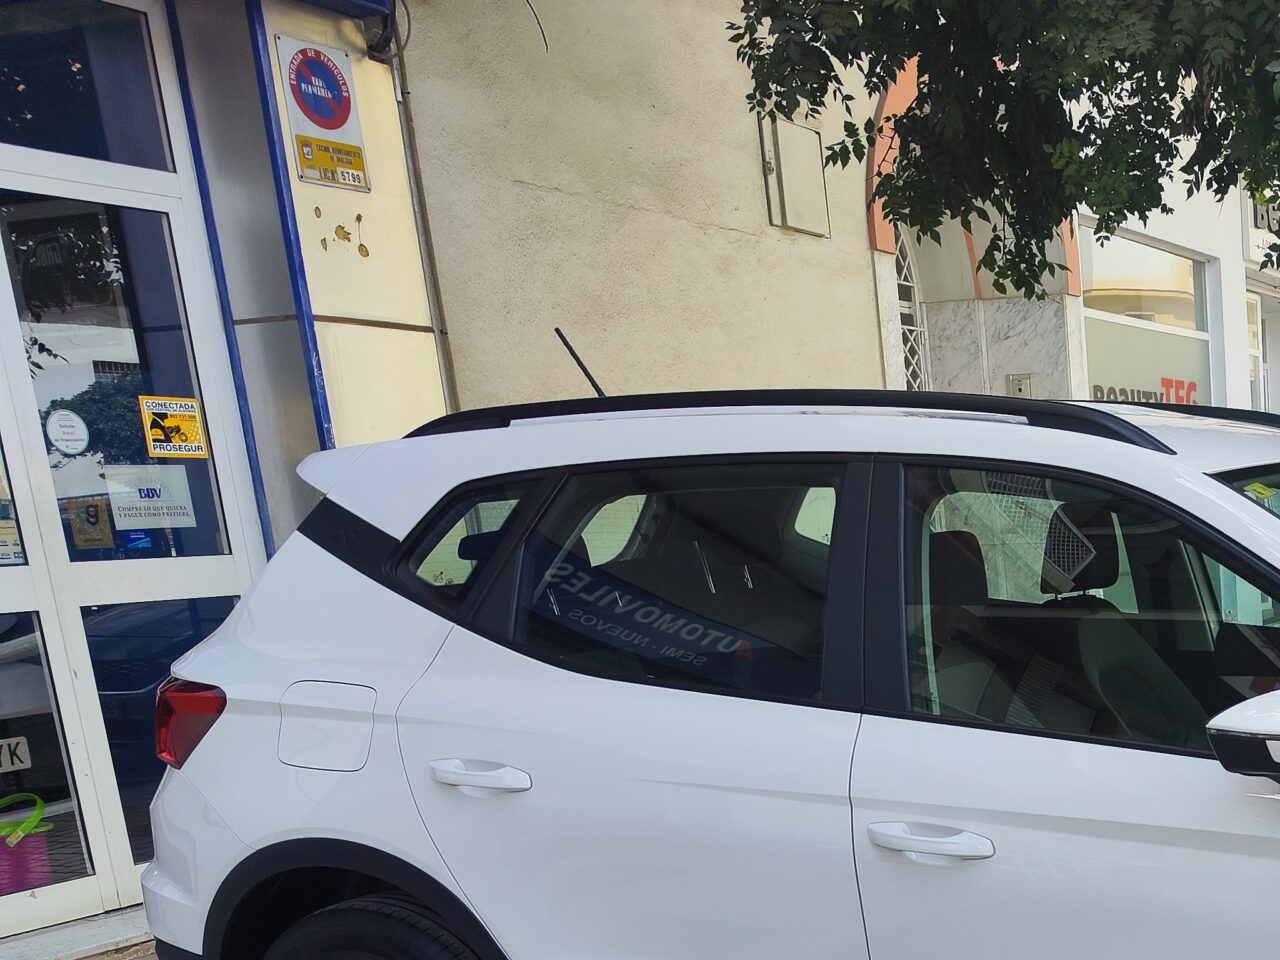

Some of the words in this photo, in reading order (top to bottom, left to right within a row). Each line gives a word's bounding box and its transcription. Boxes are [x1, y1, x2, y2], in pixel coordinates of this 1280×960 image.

[290, 52, 304, 85] ENTRADA
[306, 48, 317, 58] DE
[320, 53, 349, 97] VEHICULOS
[145, 401, 195, 410] CONECTADA
[153, 444, 204, 453] PROSEGUR
[138, 488, 161, 499] BBV
